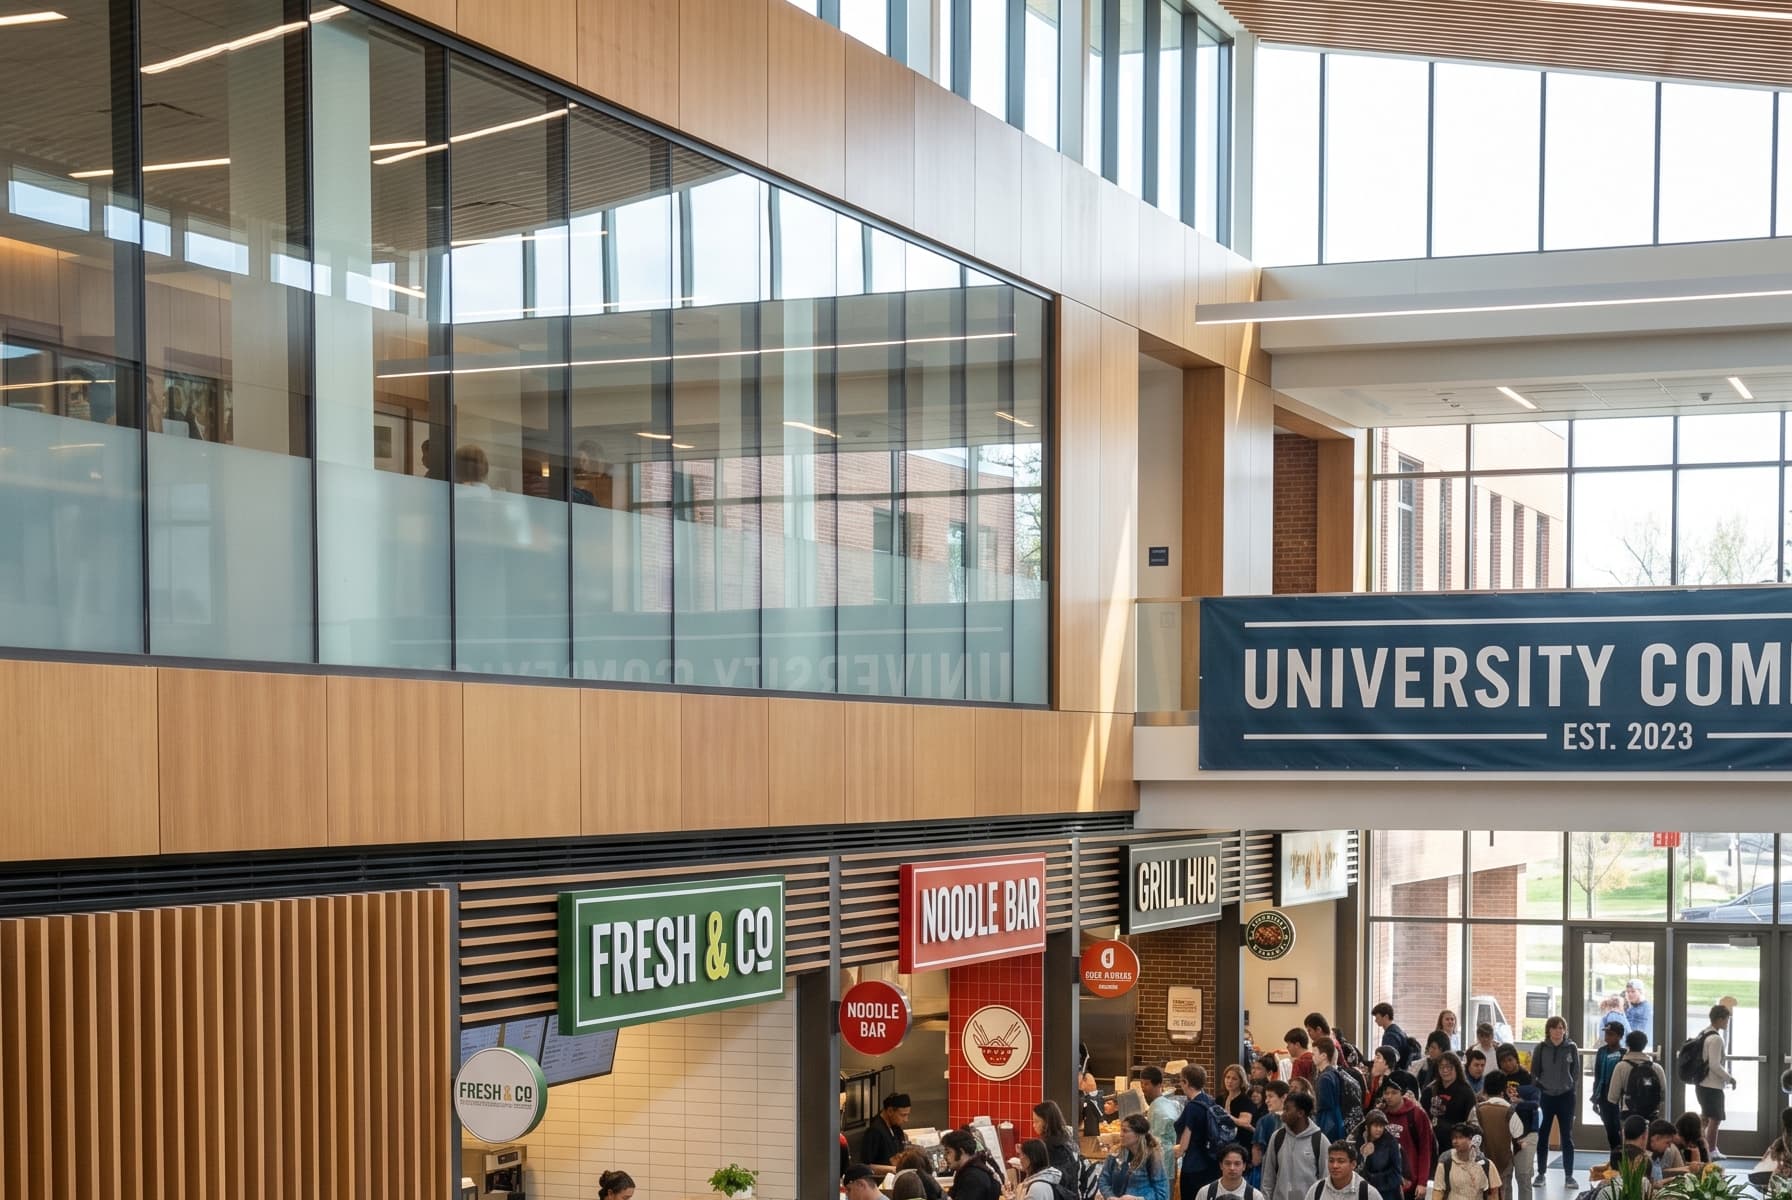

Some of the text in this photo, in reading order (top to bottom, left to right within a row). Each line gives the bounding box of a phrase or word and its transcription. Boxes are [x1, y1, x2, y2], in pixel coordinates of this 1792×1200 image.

[1244, 642, 1792, 709] UNIVERSITY COM
[1563, 722, 1693, 750] EST. 2023
[1138, 856, 1217, 912] GRILL HUB
[921, 877, 1040, 944] NOODLE BAR
[592, 914, 697, 997] FRESH
[705, 911, 730, 980] &
[847, 1002, 899, 1020] NOODLE
[860, 1022, 886, 1038] BAR
[459, 1082, 501, 1100] FRESH
